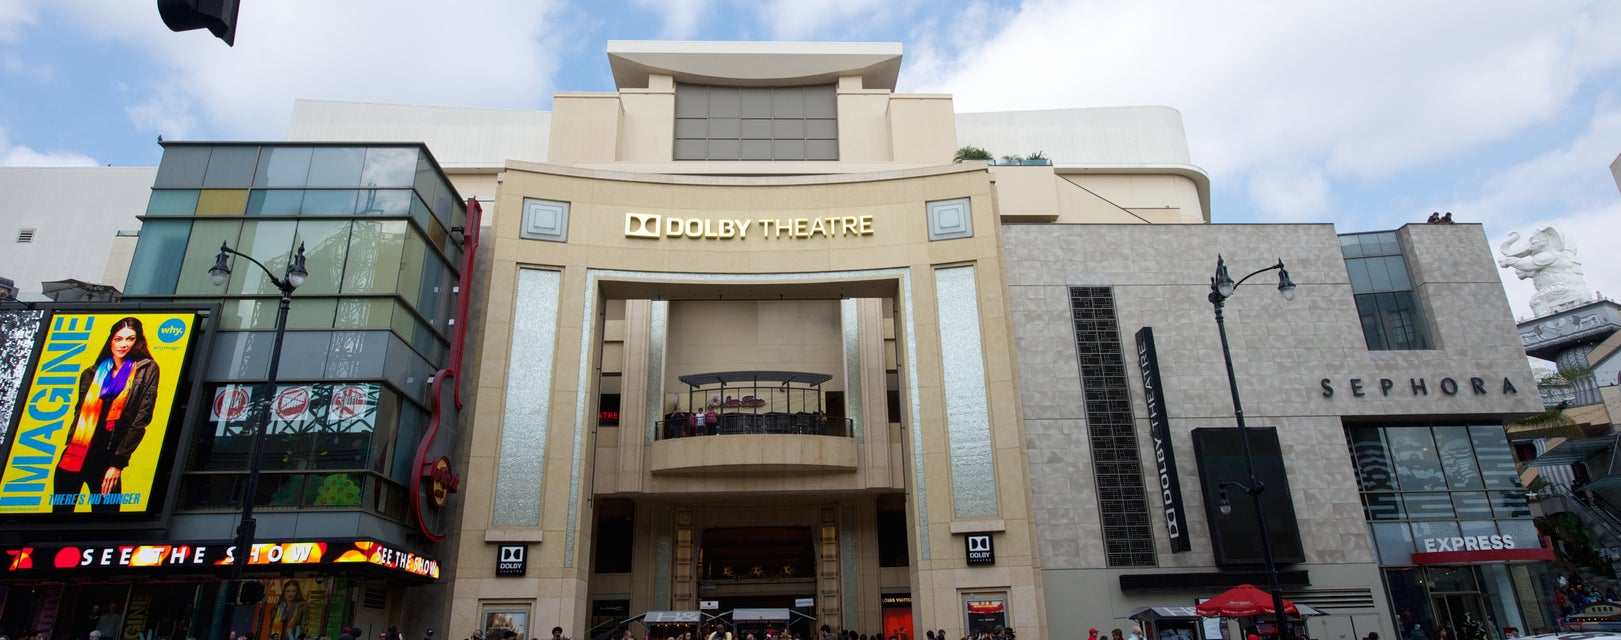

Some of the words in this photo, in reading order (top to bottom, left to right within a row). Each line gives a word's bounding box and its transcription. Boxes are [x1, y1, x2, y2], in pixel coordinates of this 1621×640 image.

[665, 217, 751, 239] DOLBY
[758, 214, 874, 239] THEATRE
[1139, 344, 1160, 432] THEATRE
[1320, 377, 1518, 398] SEPHORA
[0, 316, 95, 507] IMAGINE
[1154, 437, 1173, 505] DOLBY
[48, 493, 86, 505] THERE'S
[88, 493, 101, 505] NO
[103, 493, 141, 504] HUNGER
[1424, 534, 1515, 553] EXPRESS
[81, 548, 133, 566] SEE
[153, 547, 206, 564] THE
[376, 546, 393, 565] SEE
[396, 551, 412, 572] THE
[413, 556, 437, 577] SHOW
